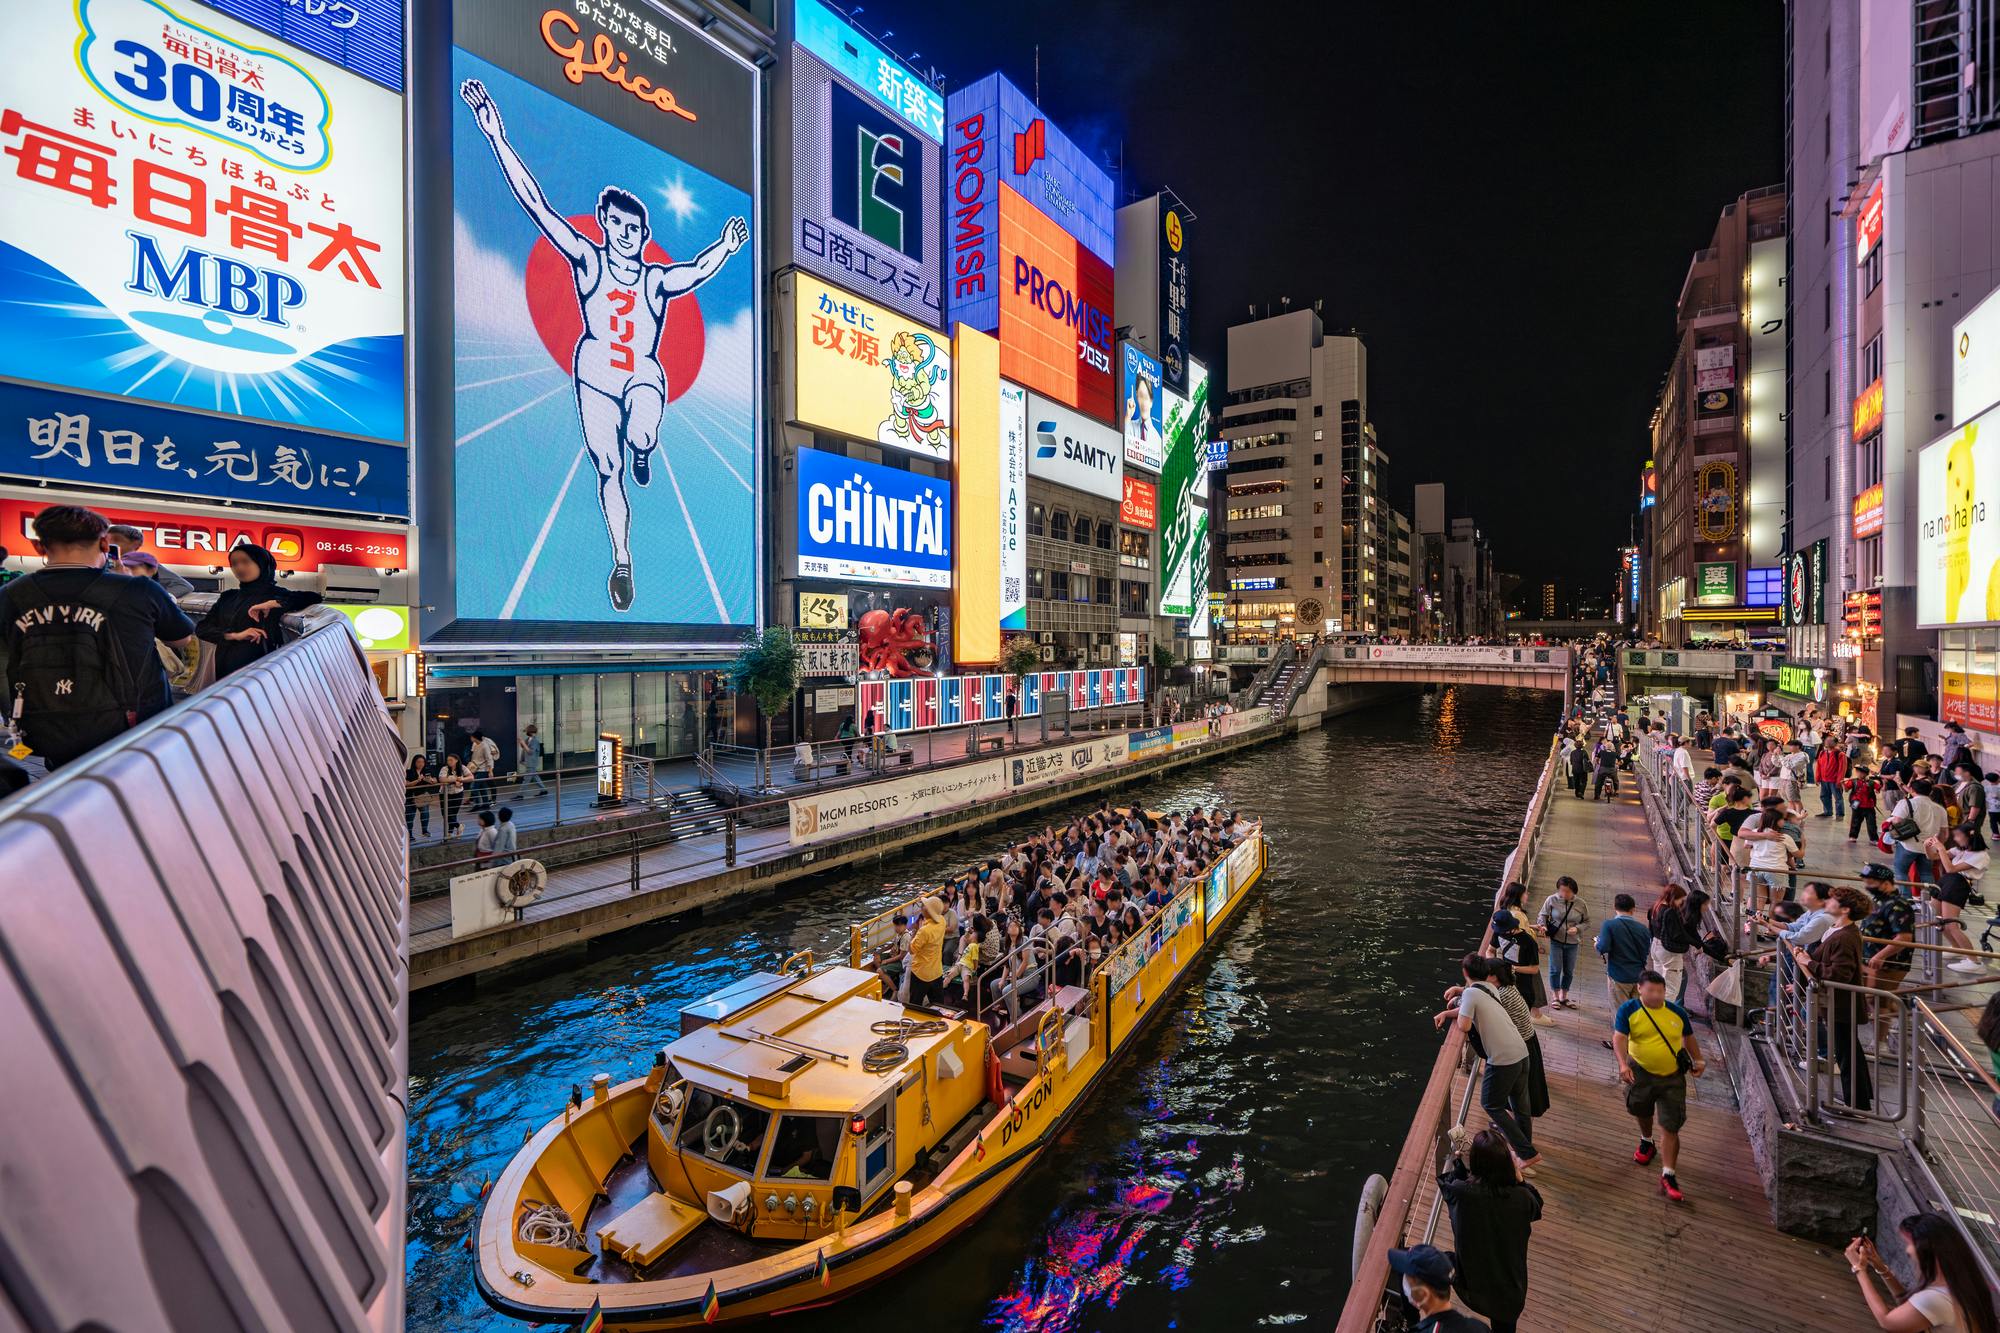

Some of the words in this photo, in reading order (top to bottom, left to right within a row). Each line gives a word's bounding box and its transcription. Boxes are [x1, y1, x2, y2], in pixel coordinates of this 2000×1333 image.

[163, 23, 265, 73] まいにちほねぶと
[575, 0, 669, 65] ゆたかな人生
[162, 32, 265, 91] 毎日骨太
[540, 9, 697, 122] Glico
[73, 107, 337, 213] まいにちほねぶと
[226, 115, 305, 155] ありがとう
[0, 108, 383, 290] 毎日骨太
[955, 112, 985, 299] PROMISE
[128, 233, 304, 326] MBP
[802, 218, 941, 311] 日商エステム
[819, 293, 875, 332] かぜに
[1014, 254, 1111, 351] PROMISE
[606, 288, 637, 372] グリコ
[811, 314, 881, 368] 改源
[1078, 340, 1111, 375] プロミス
[1002, 388, 1017, 401] Asue
[26, 412, 371, 496] 明日を、元気に！
[1063, 435, 1117, 475] SAMTY
[808, 473, 944, 556] CHINTAI
[1008, 487, 1017, 551] Asue
[804, 561, 829, 573] 天気予報
[1704, 566, 1728, 585] 薬
[15, 605, 54, 633] NEW
[58, 605, 106, 633] YRK
[808, 597, 839, 624] くくる
[55, 678, 74, 696] NY
[1779, 666, 1790, 692] LEE
[1790, 667, 1810, 696] MART
[1026, 752, 1064, 775] 近畿大学
[819, 806, 847, 823] MGM
[849, 795, 899, 816] RESORTS
[820, 822, 839, 831] JAPAN
